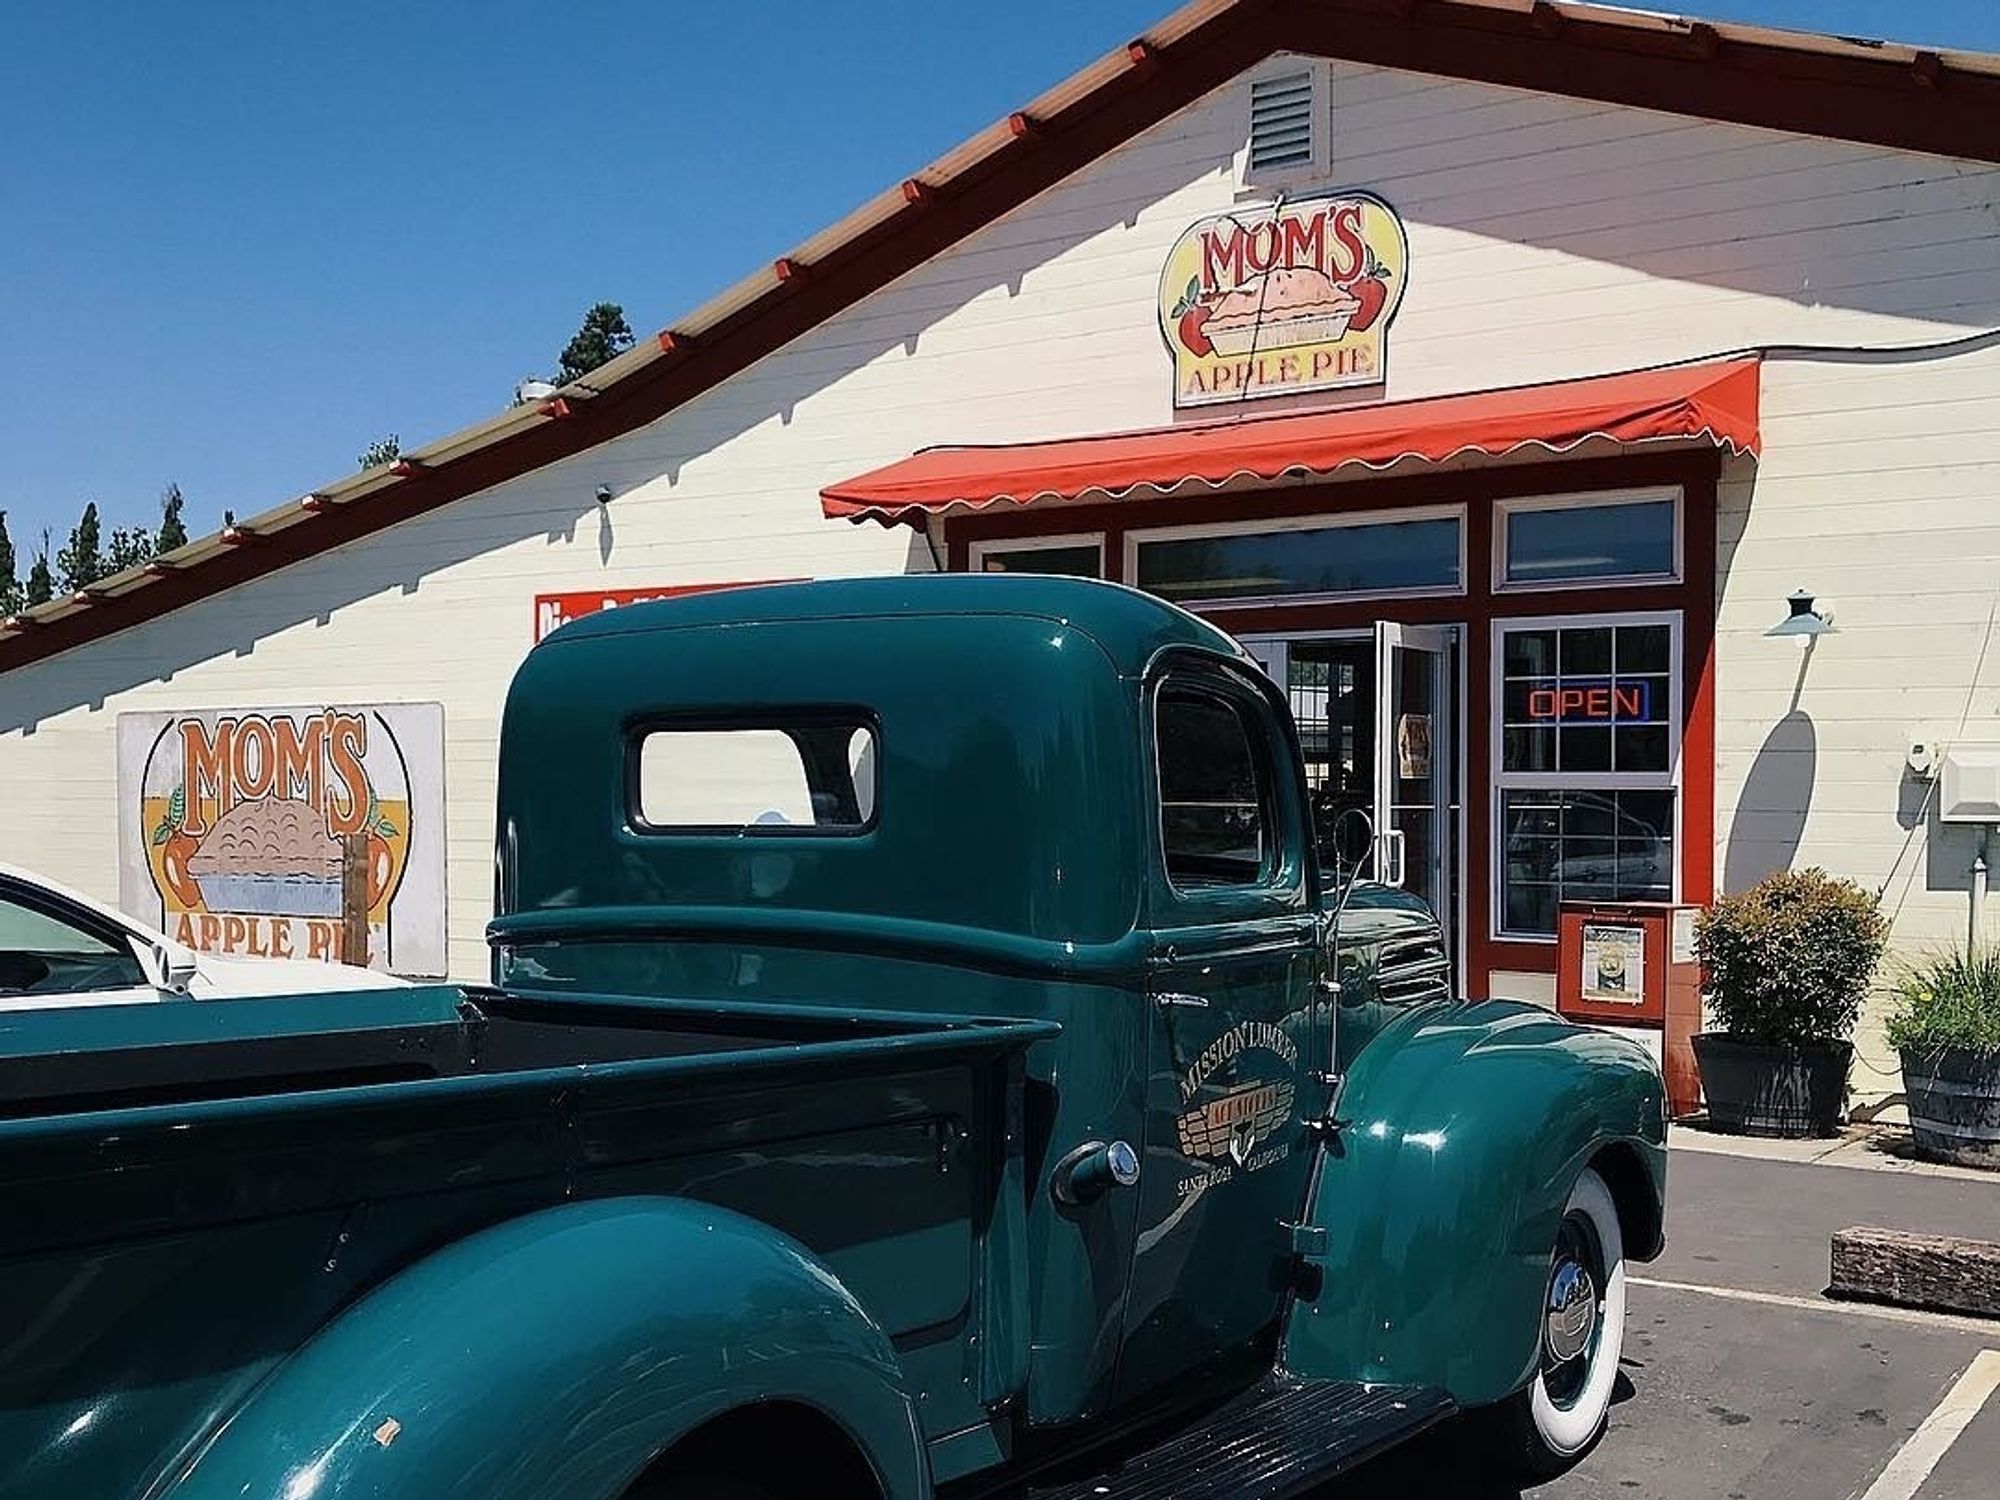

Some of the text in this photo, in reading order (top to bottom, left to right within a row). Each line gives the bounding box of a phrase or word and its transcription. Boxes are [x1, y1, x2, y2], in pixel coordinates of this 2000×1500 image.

[1200, 202, 1365, 291] MOM'S
[1185, 345, 1375, 394] APPLE PIE
[1529, 688, 1640, 717] OPEN
[178, 709, 367, 838] MOM'S
[175, 912, 375, 966] APPLE PI
[1179, 1020, 1298, 1105] MISSION LUMBER
[1177, 1173, 1209, 1197] SANTA
